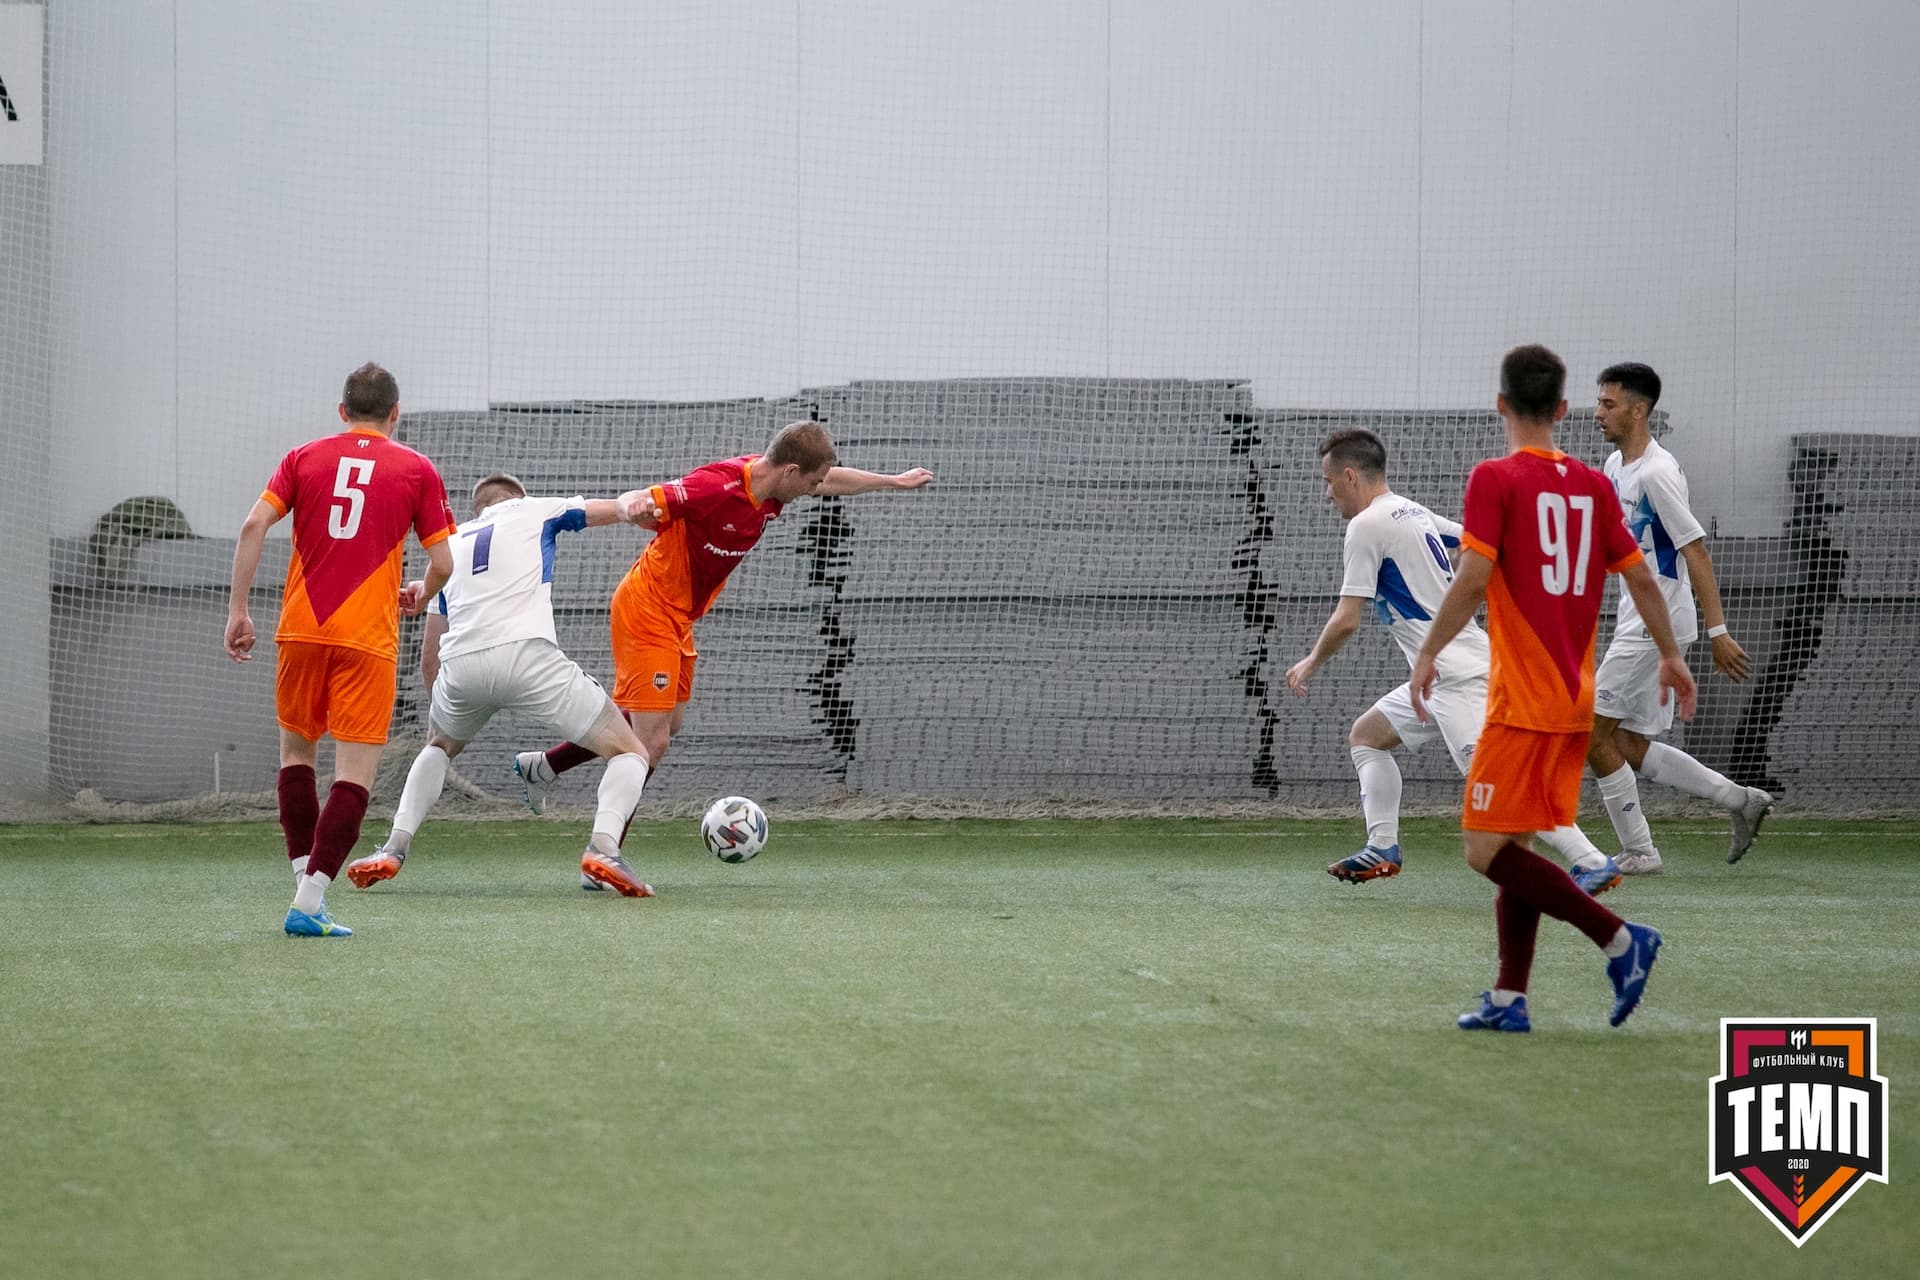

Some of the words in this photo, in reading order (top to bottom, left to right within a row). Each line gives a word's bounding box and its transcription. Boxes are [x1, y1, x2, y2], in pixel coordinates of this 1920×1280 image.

[328, 456, 376, 540] 5
[461, 523, 494, 576] 7
[1537, 491, 1593, 596] 97
[1472, 782, 1495, 811] 97
